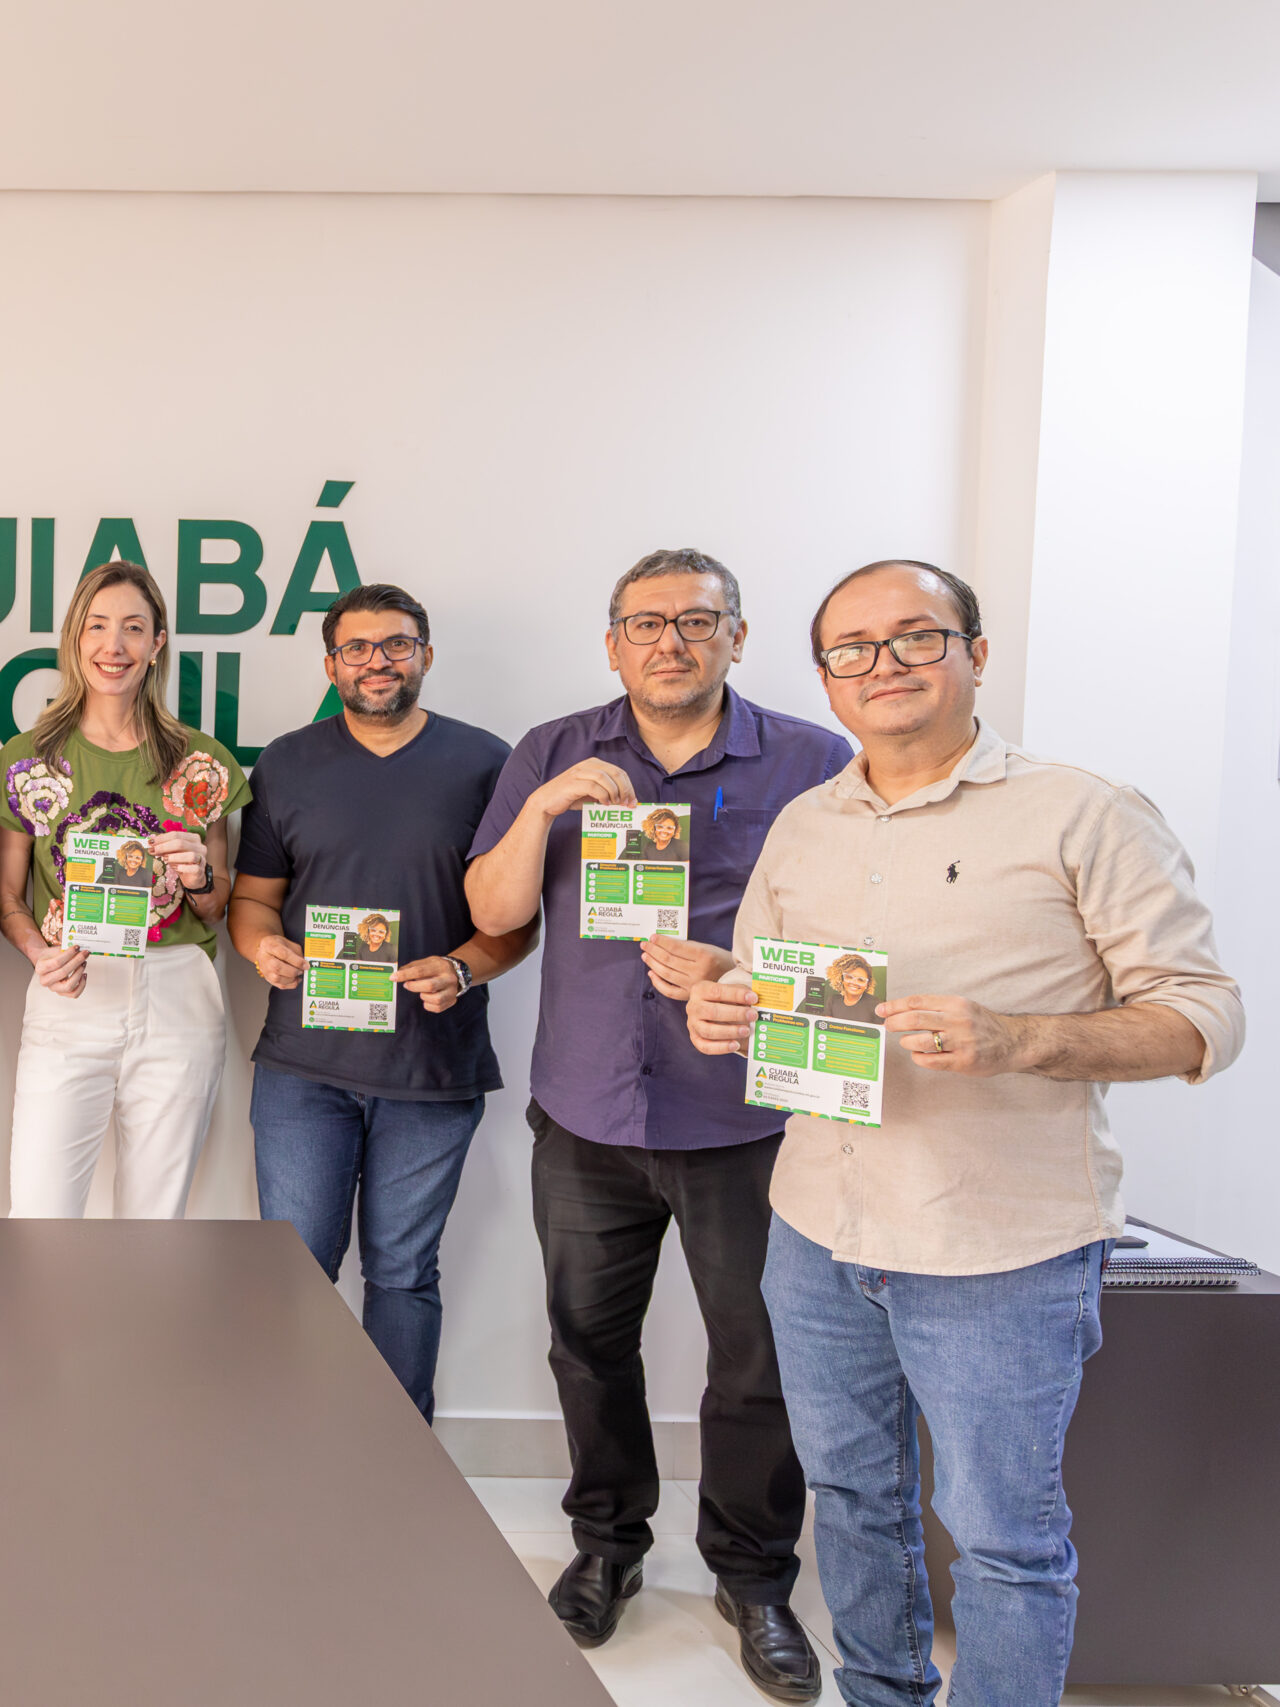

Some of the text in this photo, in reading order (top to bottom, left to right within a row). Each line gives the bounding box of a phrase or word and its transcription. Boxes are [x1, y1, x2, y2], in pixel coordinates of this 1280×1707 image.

[588, 810, 633, 821] WEB
[73, 838, 110, 850] WEB
[312, 912, 350, 925] WEB
[760, 946, 815, 966] WEB
[762, 962, 815, 975] DENÚNCIAS
[769, 1067, 799, 1079] CUIABÁ
[769, 1073, 799, 1085] REGULA
